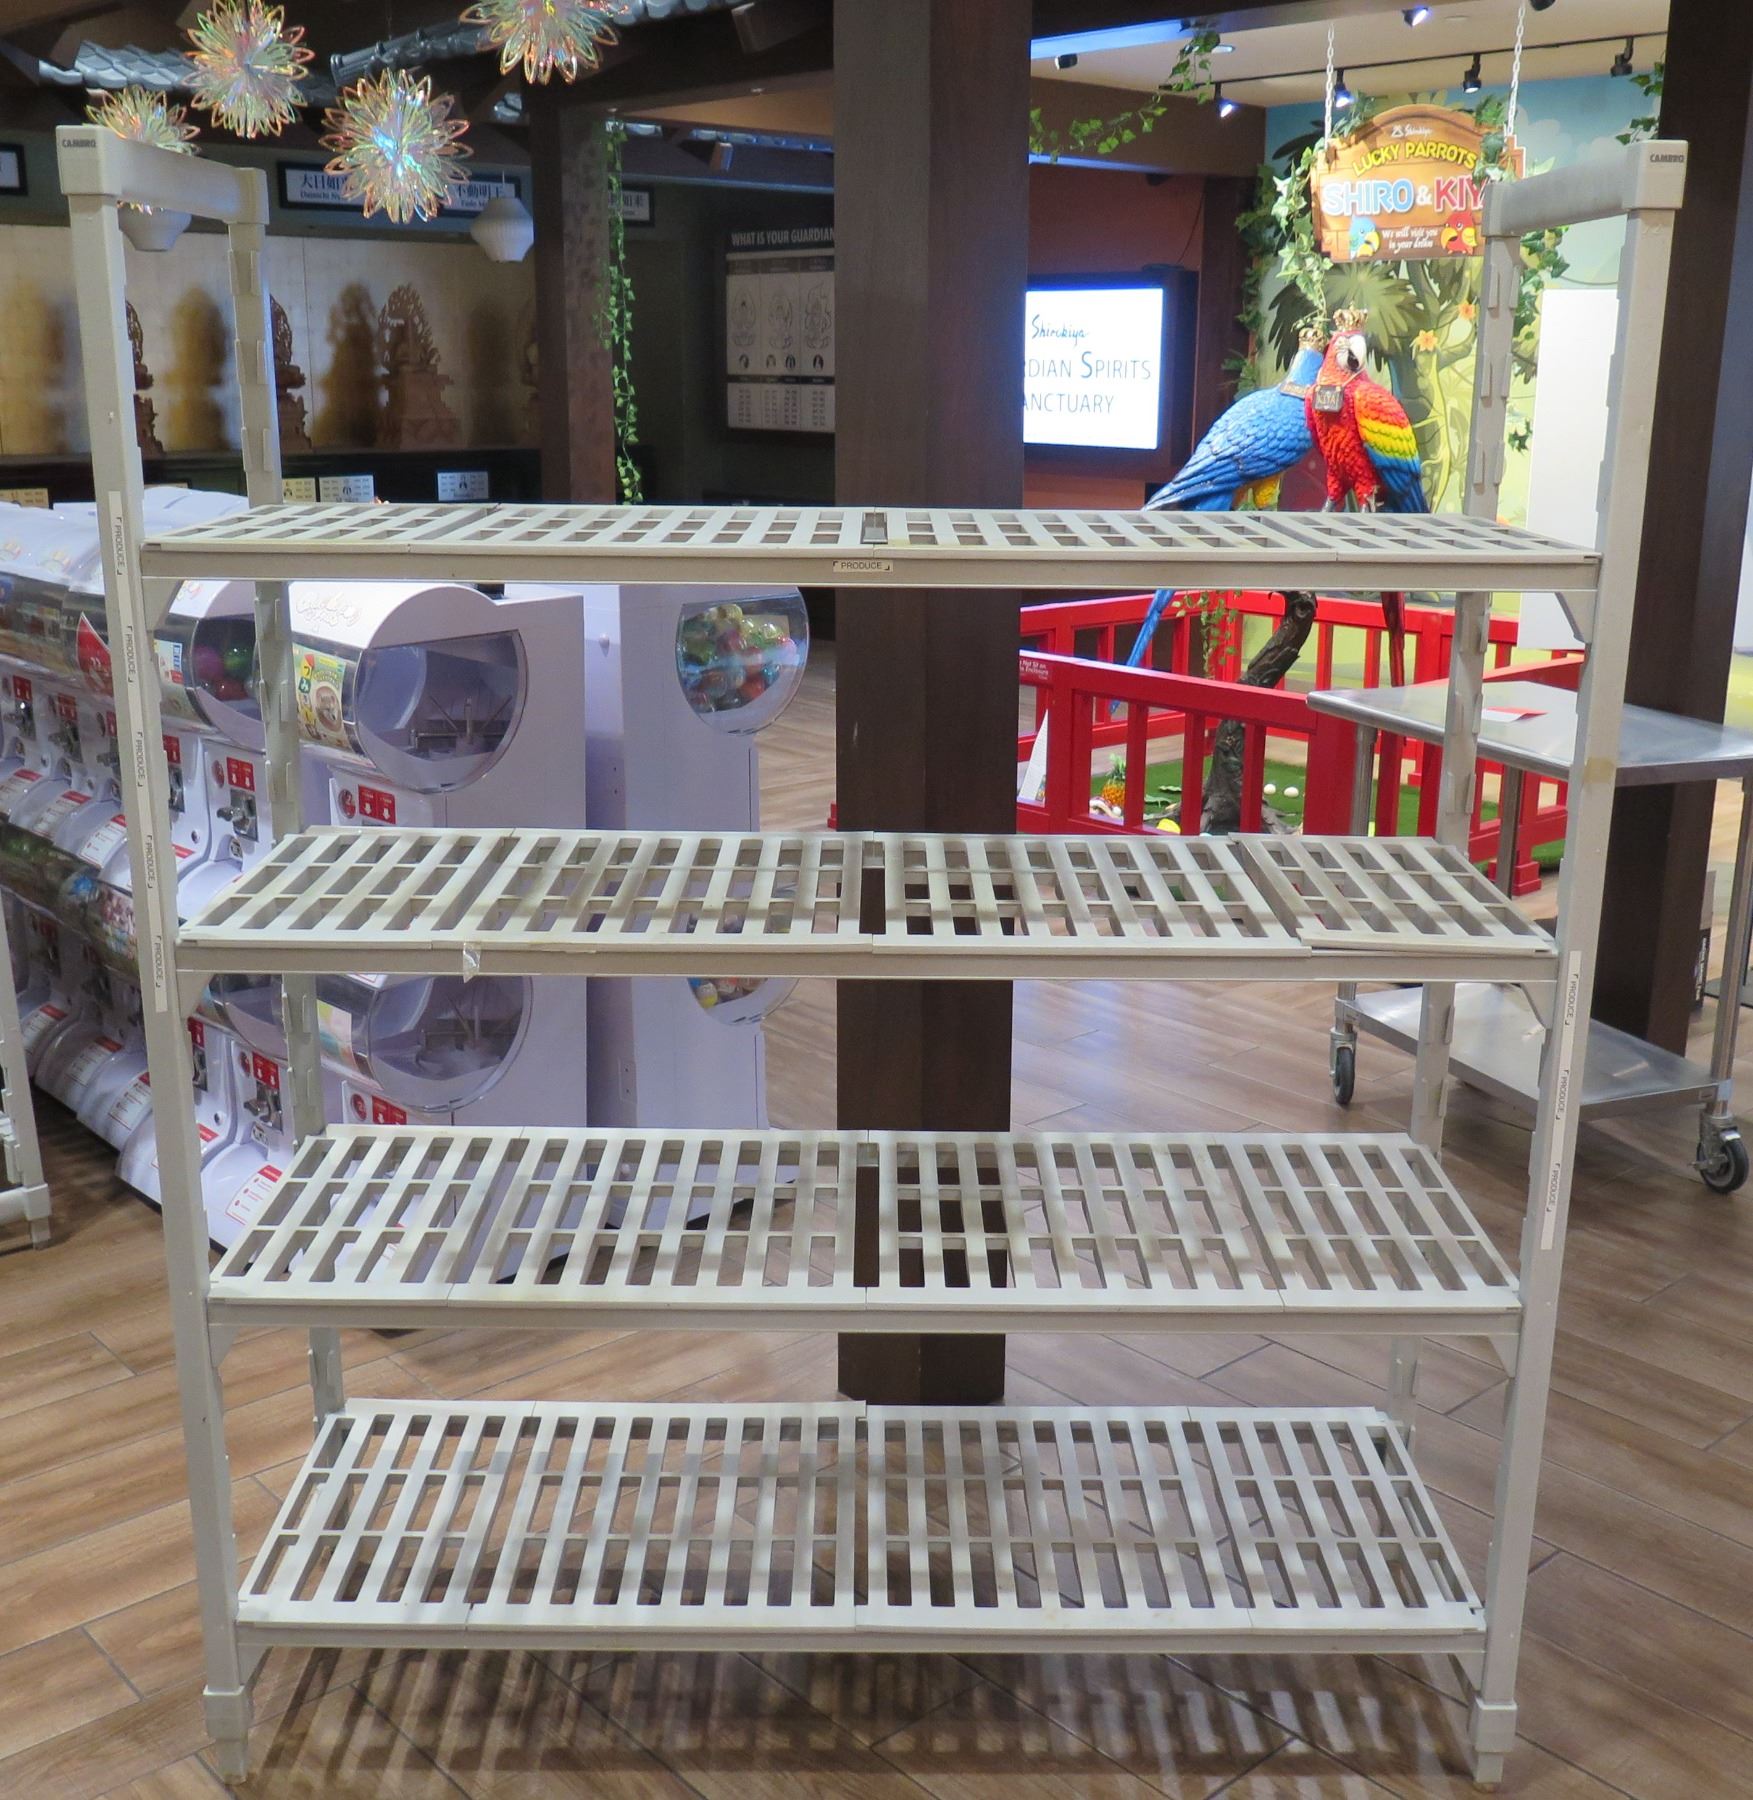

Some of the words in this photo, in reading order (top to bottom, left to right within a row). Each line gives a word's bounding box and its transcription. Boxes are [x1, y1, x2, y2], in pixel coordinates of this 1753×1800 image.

[62, 138, 97, 148] CAMBRO
[1352, 144, 1400, 177] LUCKY
[1405, 141, 1478, 170] PARROTS
[1649, 153, 1685, 163] CAMBRO
[1322, 179, 1415, 216] SHIRO
[1416, 185, 1433, 206] &
[1433, 174, 1485, 213] KIY
[731, 231, 755, 247] WHAT
[757, 231, 765, 246] IS
[767, 229, 789, 245] YOUR
[1024, 358, 1073, 379] DIAN
[1080, 350, 1152, 380] SPIRITS
[114, 525, 125, 568] PRODUCE
[841, 561, 882, 570] PRODUCE
[124, 633, 136, 675] PRODUCE
[136, 738, 146, 780] PRODUCE
[146, 842, 156, 882] PRODUCE
[154, 942, 164, 981] PRODUCE
[1567, 981, 1577, 1019] PRODUCE
[1557, 1077, 1569, 1113] PRODUCE
[1549, 1169, 1559, 1206] PRODUCE
